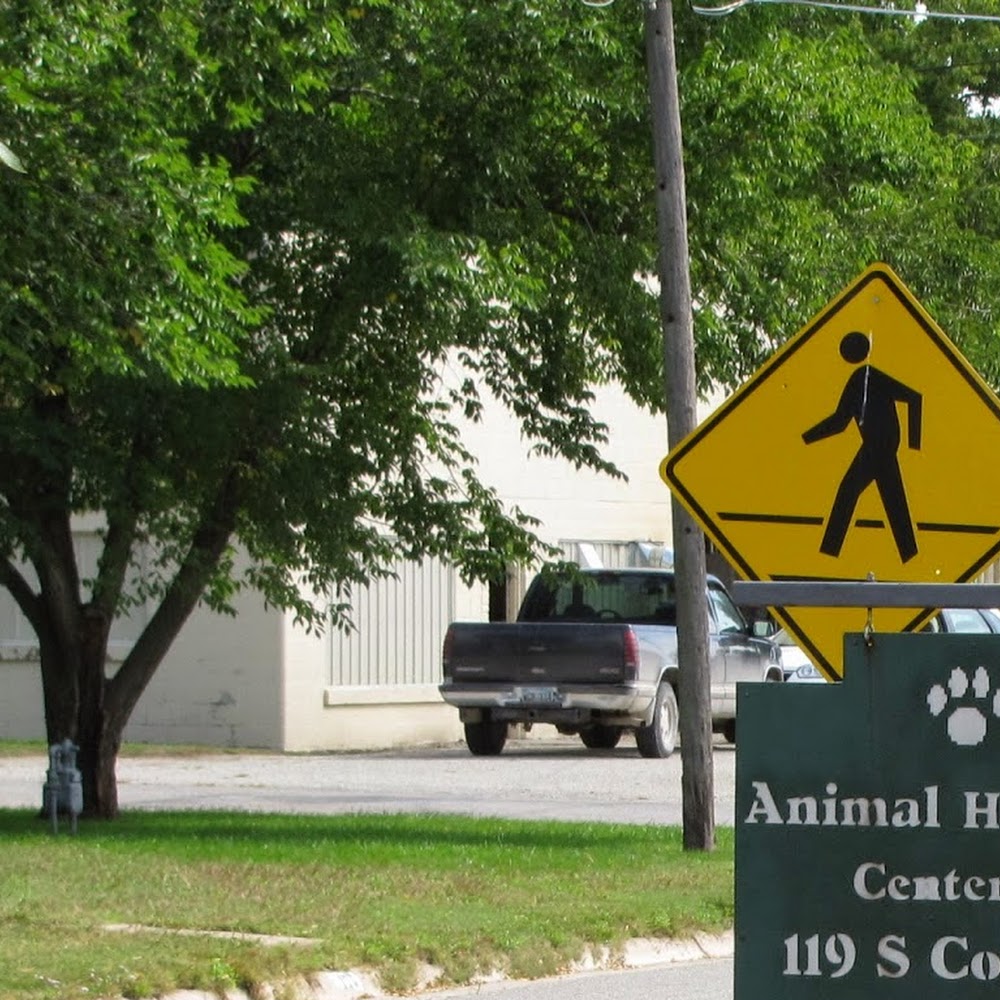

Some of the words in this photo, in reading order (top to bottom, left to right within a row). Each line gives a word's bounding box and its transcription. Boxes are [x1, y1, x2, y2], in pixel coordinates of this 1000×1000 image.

[745, 782, 940, 827] Animal
[782, 933, 856, 978] 119
[877, 934, 910, 978] S
